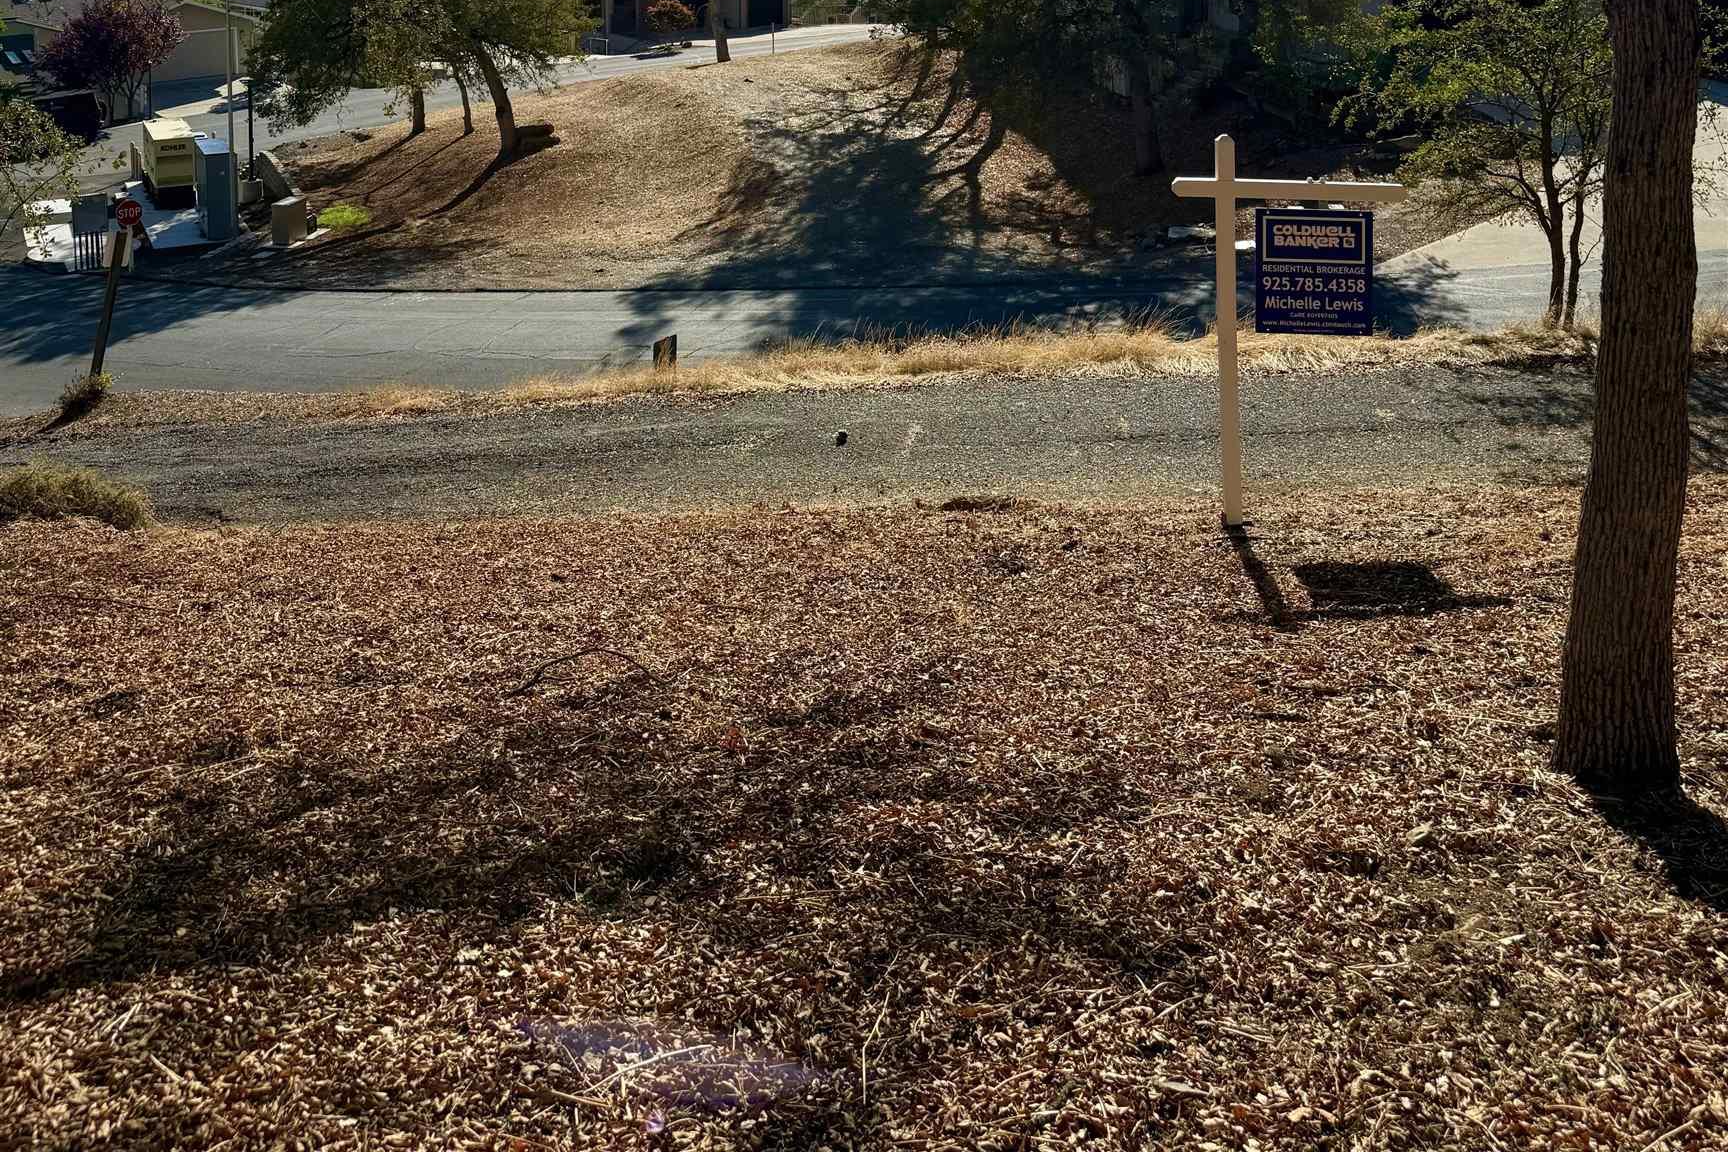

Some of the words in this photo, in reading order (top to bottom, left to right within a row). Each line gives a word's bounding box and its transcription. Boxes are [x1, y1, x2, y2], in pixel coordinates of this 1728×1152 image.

[118, 207, 141, 220] STOP
[1262, 264, 1314, 274] RESIDENTIAL
[1316, 266, 1366, 275] BROKERAGE
[1263, 276, 1366, 293] 925.785.4358
[1264, 295, 1321, 310] Michelle
[1325, 297, 1364, 312] Lewis
